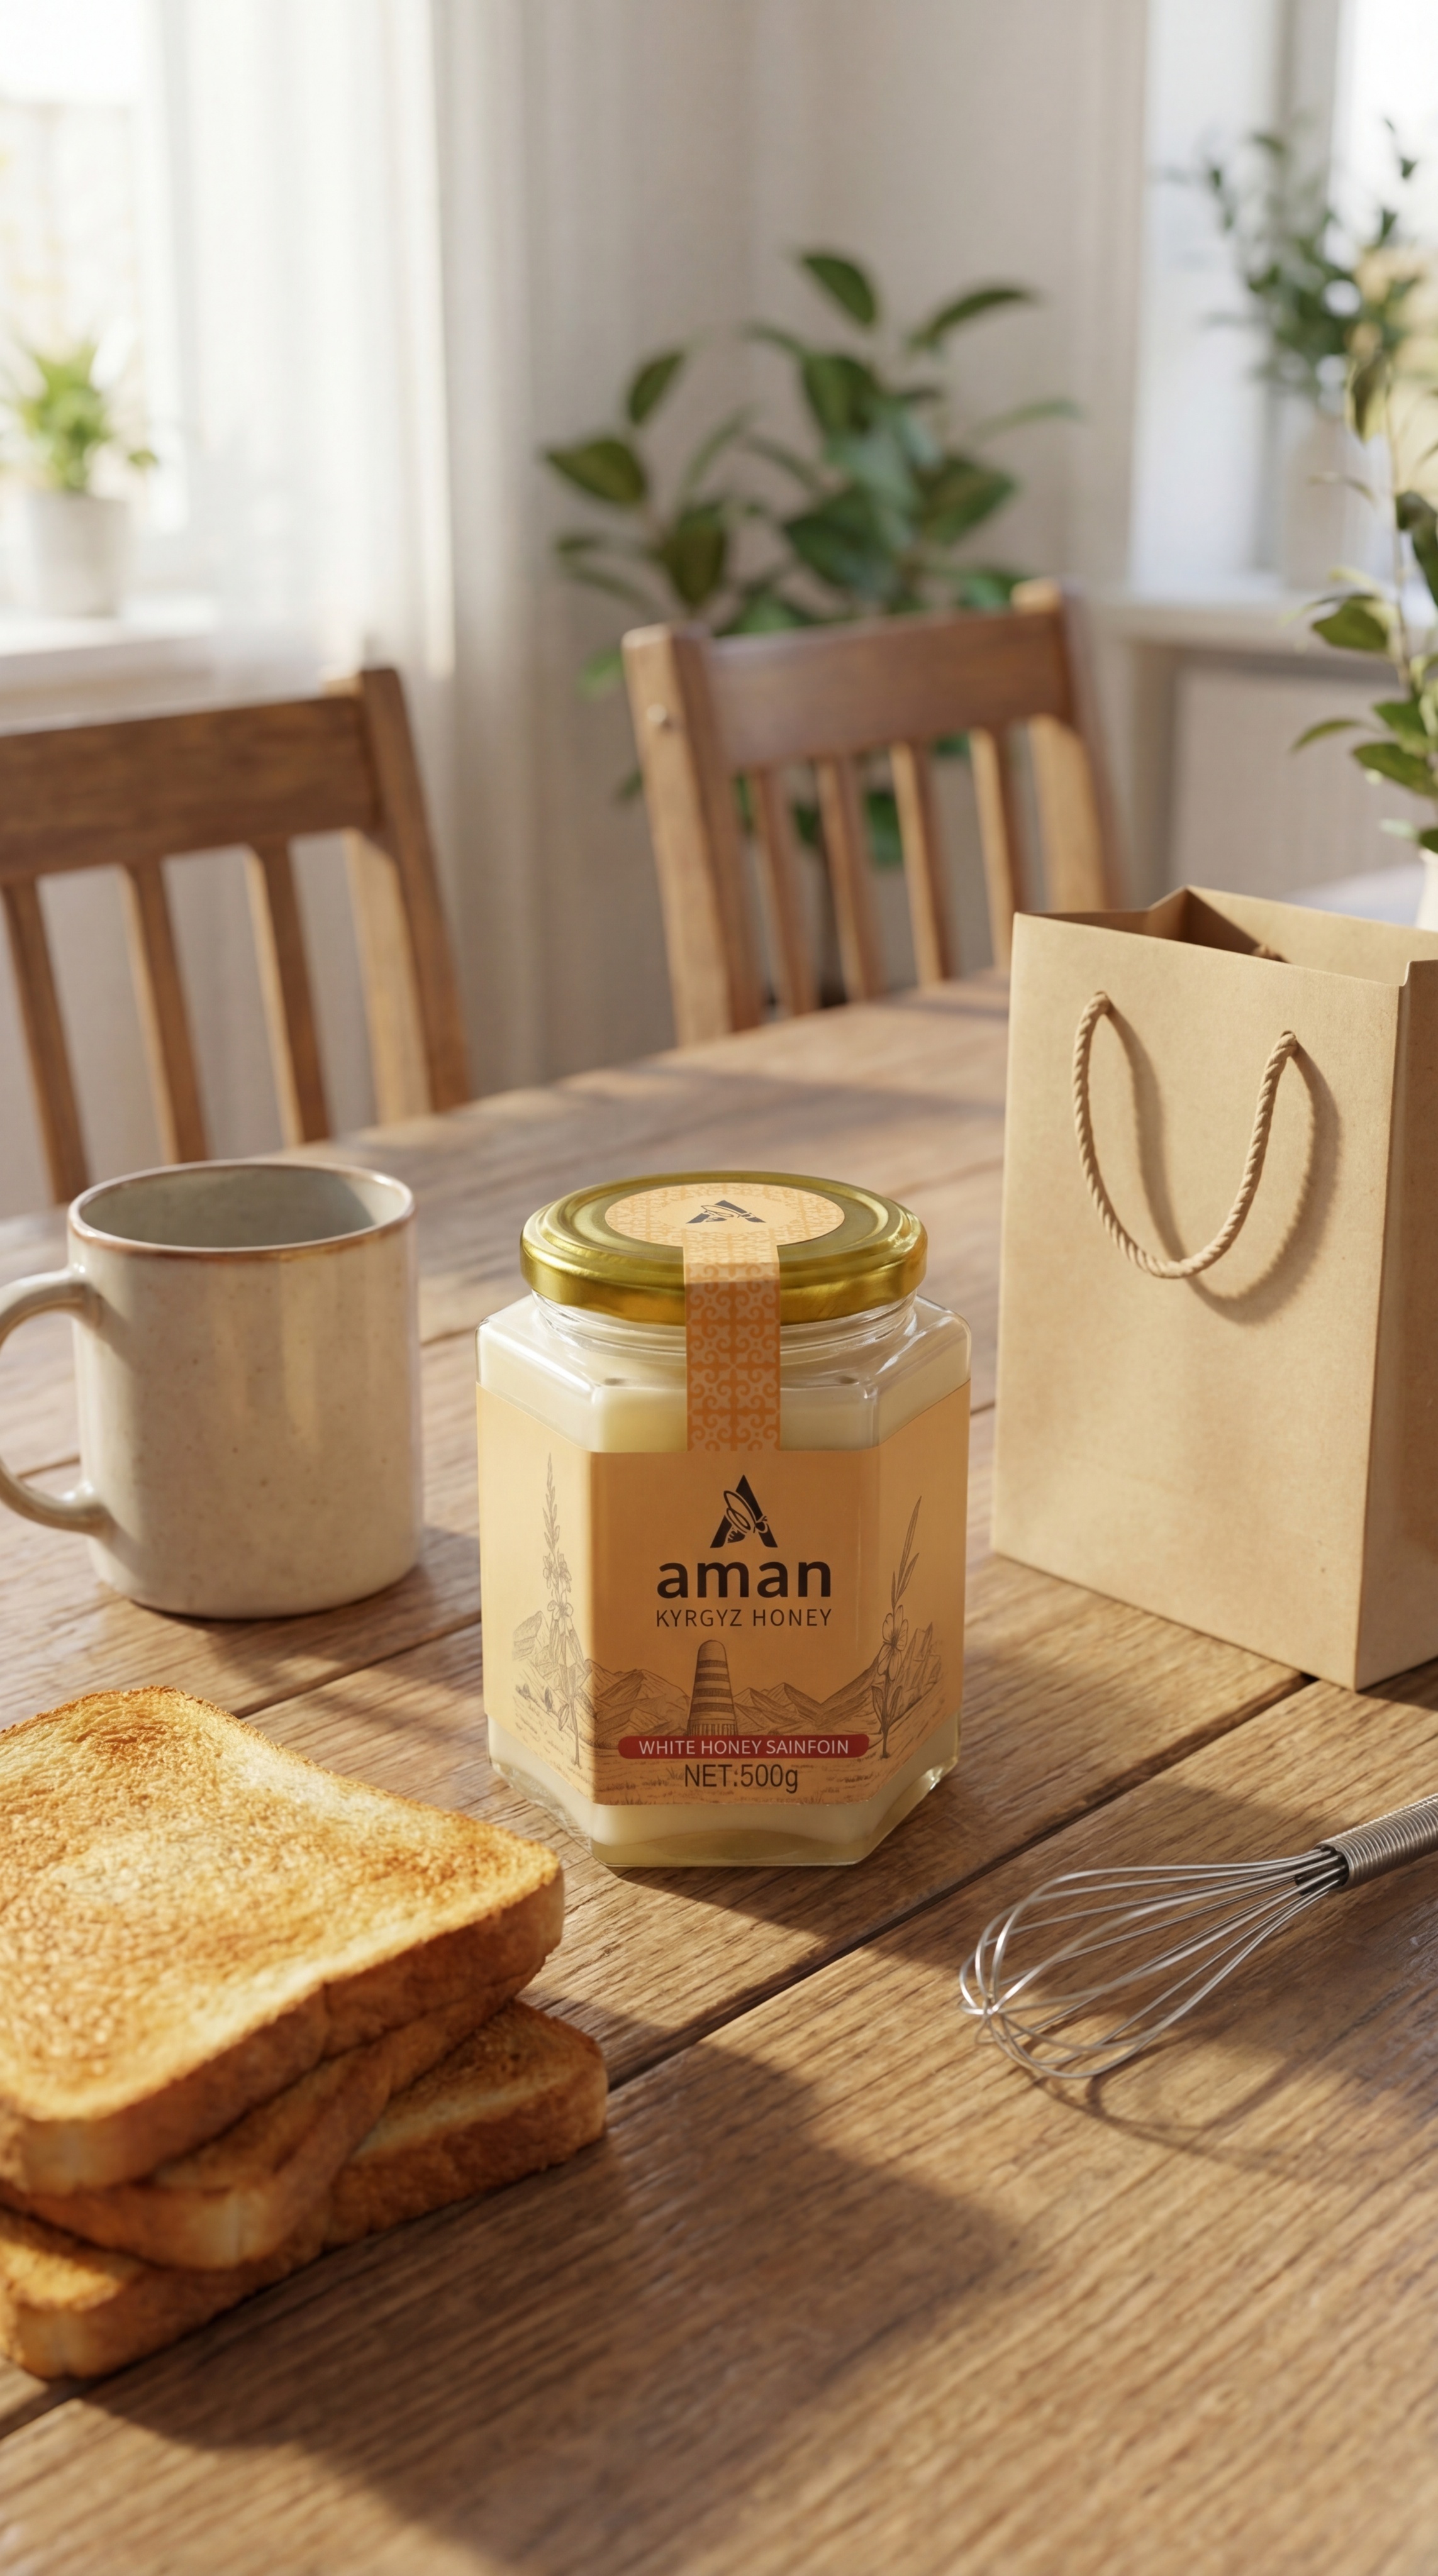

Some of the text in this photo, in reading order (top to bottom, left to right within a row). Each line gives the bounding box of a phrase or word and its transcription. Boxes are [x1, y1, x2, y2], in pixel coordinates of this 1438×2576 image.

[656, 1562, 832, 1599] aman
[656, 1608, 832, 1627] KYRGYZ HONEY
[639, 1740, 849, 1755] WHITE HONEY SAINFOIN
